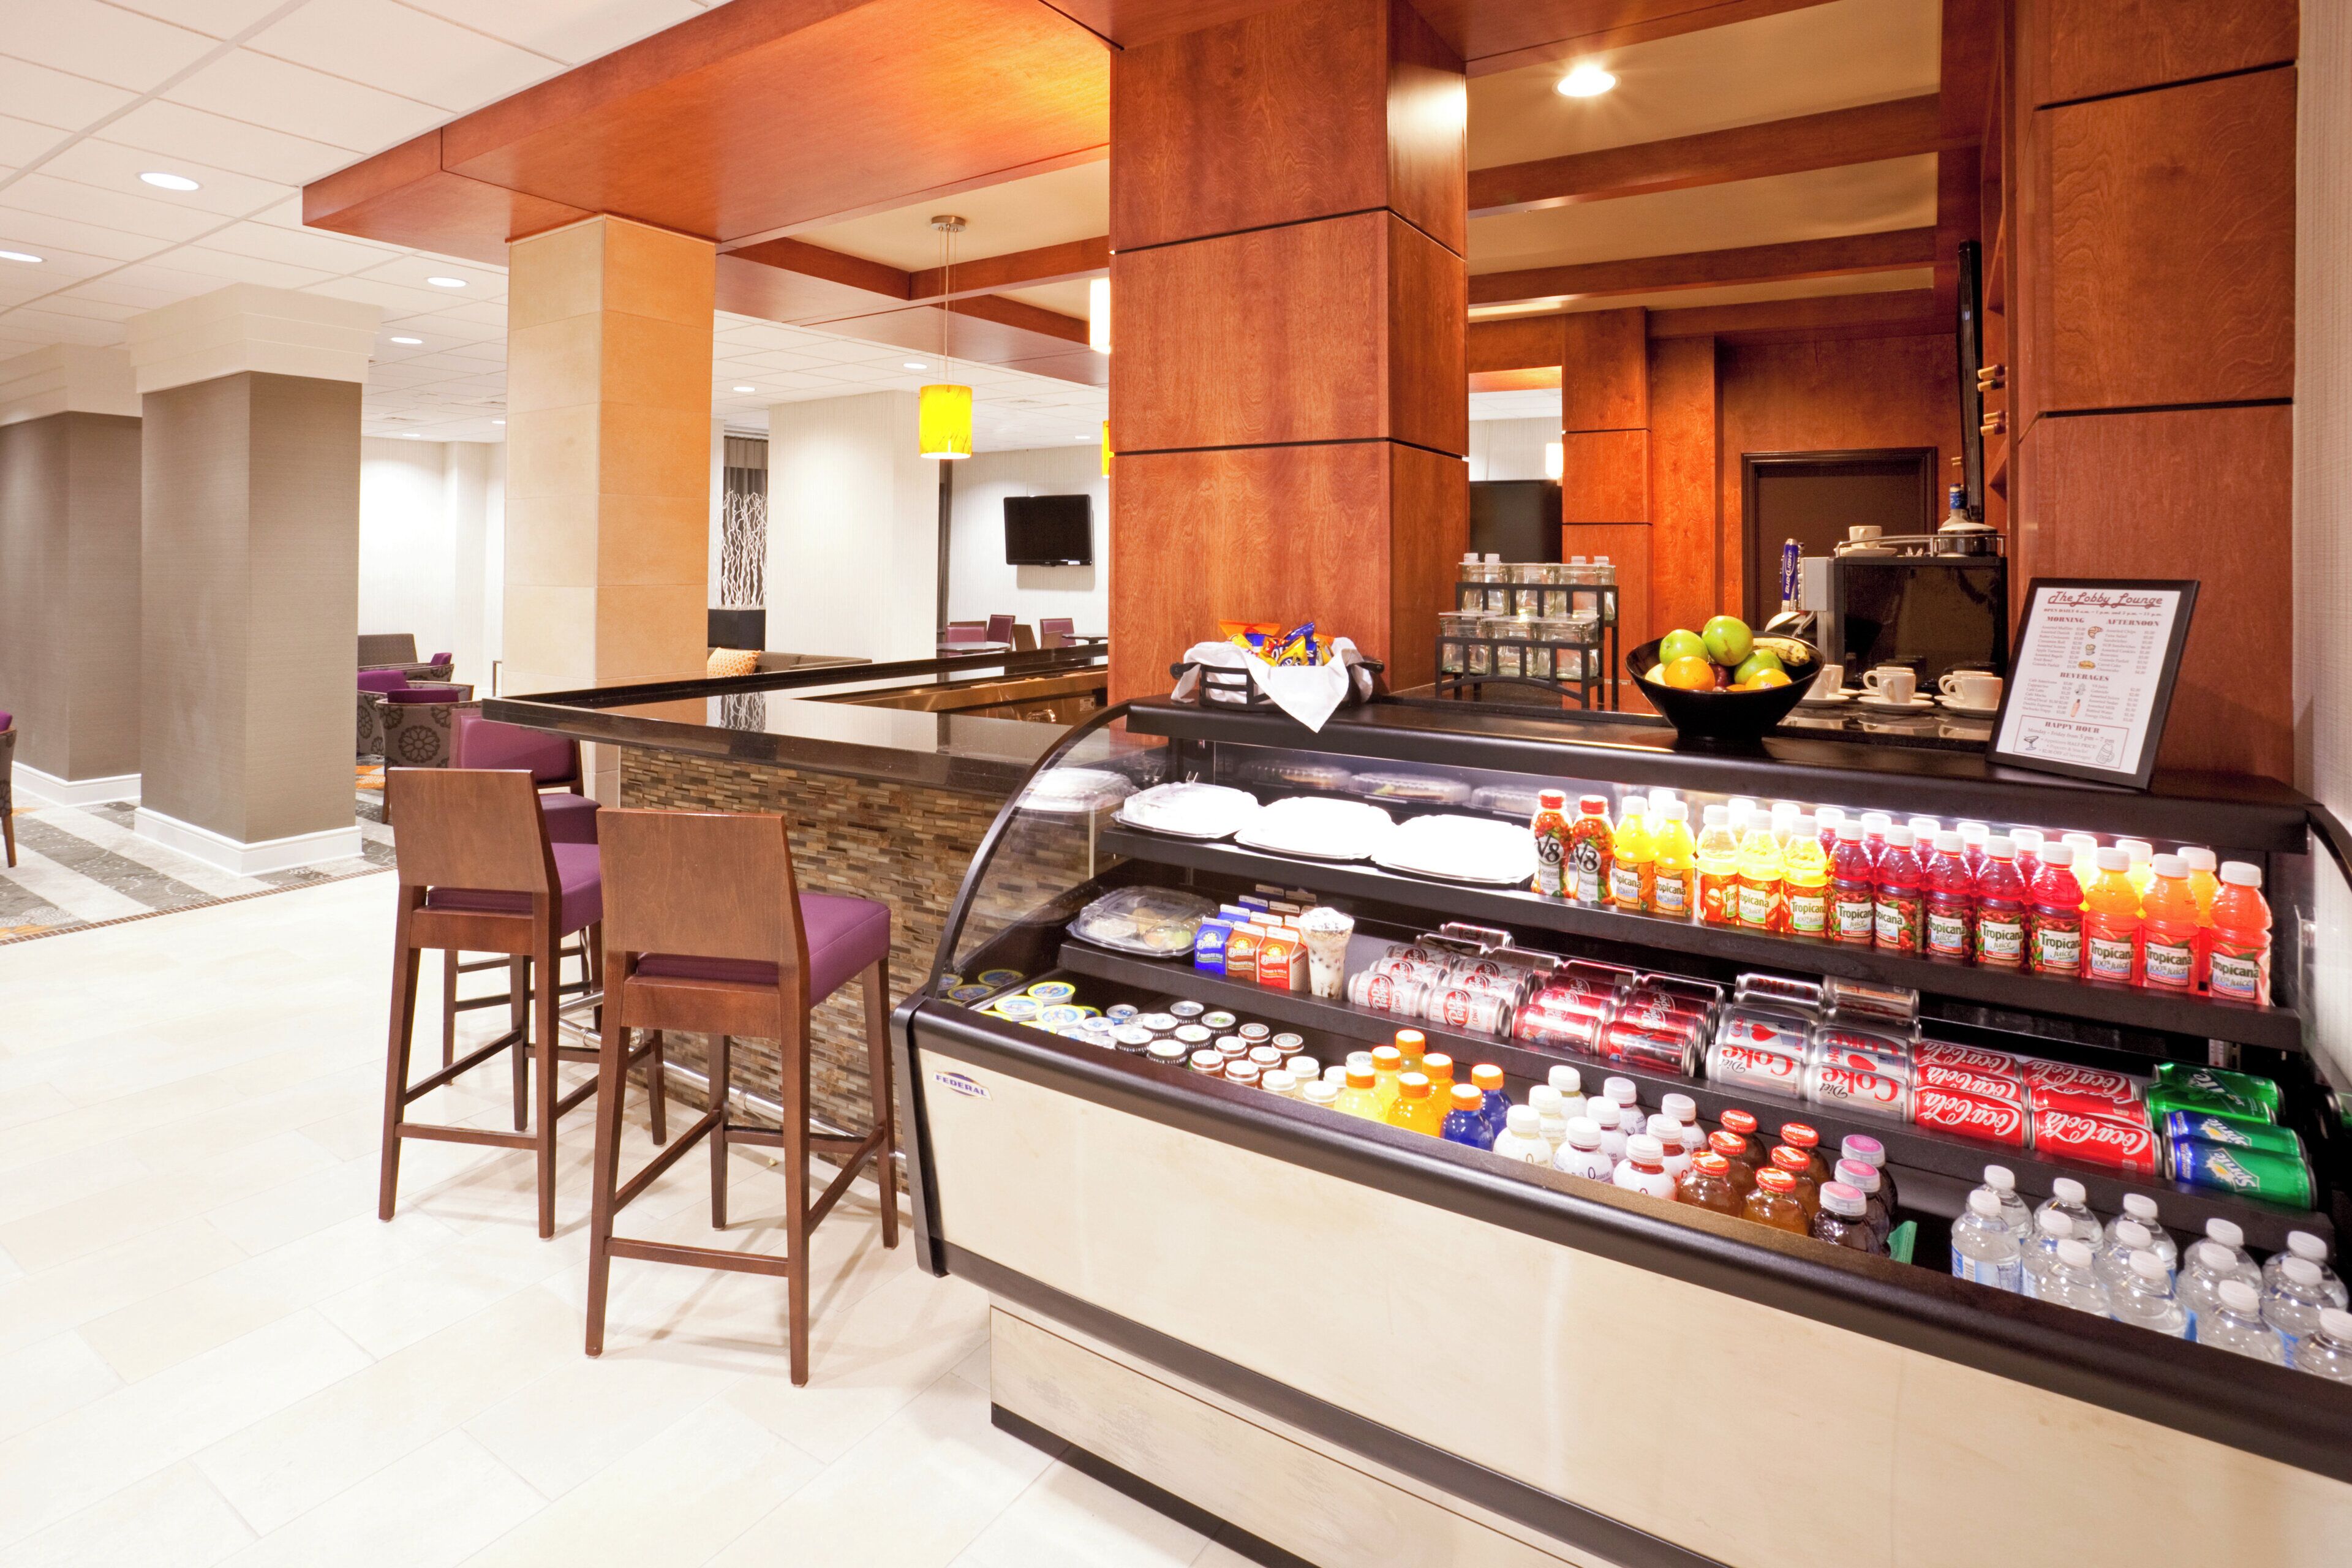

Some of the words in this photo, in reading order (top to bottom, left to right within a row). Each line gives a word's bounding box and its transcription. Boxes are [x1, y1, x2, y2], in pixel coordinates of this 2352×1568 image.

[2048, 591, 2073, 605] The
[2070, 592, 2111, 608] Lobby
[2112, 593, 2163, 609] Lounge
[2060, 672, 2109, 682] BEVERAGES
[2045, 722, 2073, 730] HAPPY
[2076, 725, 2100, 733] HOUR
[1536, 834, 1560, 862] V8
[1574, 842, 1597, 871] V8
[1981, 924, 2023, 941] Tropicana
[2090, 940, 2134, 959] Tropicana
[2146, 945, 2192, 965] Tropicana
[2210, 954, 2259, 978] Tropicana
[1371, 984, 1382, 997] Dr
[1374, 978, 1391, 1009] Pepper
[1447, 999, 1457, 1011] Dr
[1450, 991, 1465, 1024] Pepper
[1722, 1044, 1795, 1076] Coke
[1919, 1041, 2012, 1075] Coca-Cola
[936, 1074, 987, 1096] FEDERAL
[1818, 1083, 1849, 1099] Diet
[1821, 1066, 1899, 1102] Coke
[2028, 1061, 2128, 1095] Coca-Cola
[1920, 1091, 2019, 1136] Coca-Cola
[2040, 1110, 2149, 1155] Coca-Cola
[2207, 1118, 2250, 1148] Sprite
[2214, 1152, 2256, 1188] Sprite
